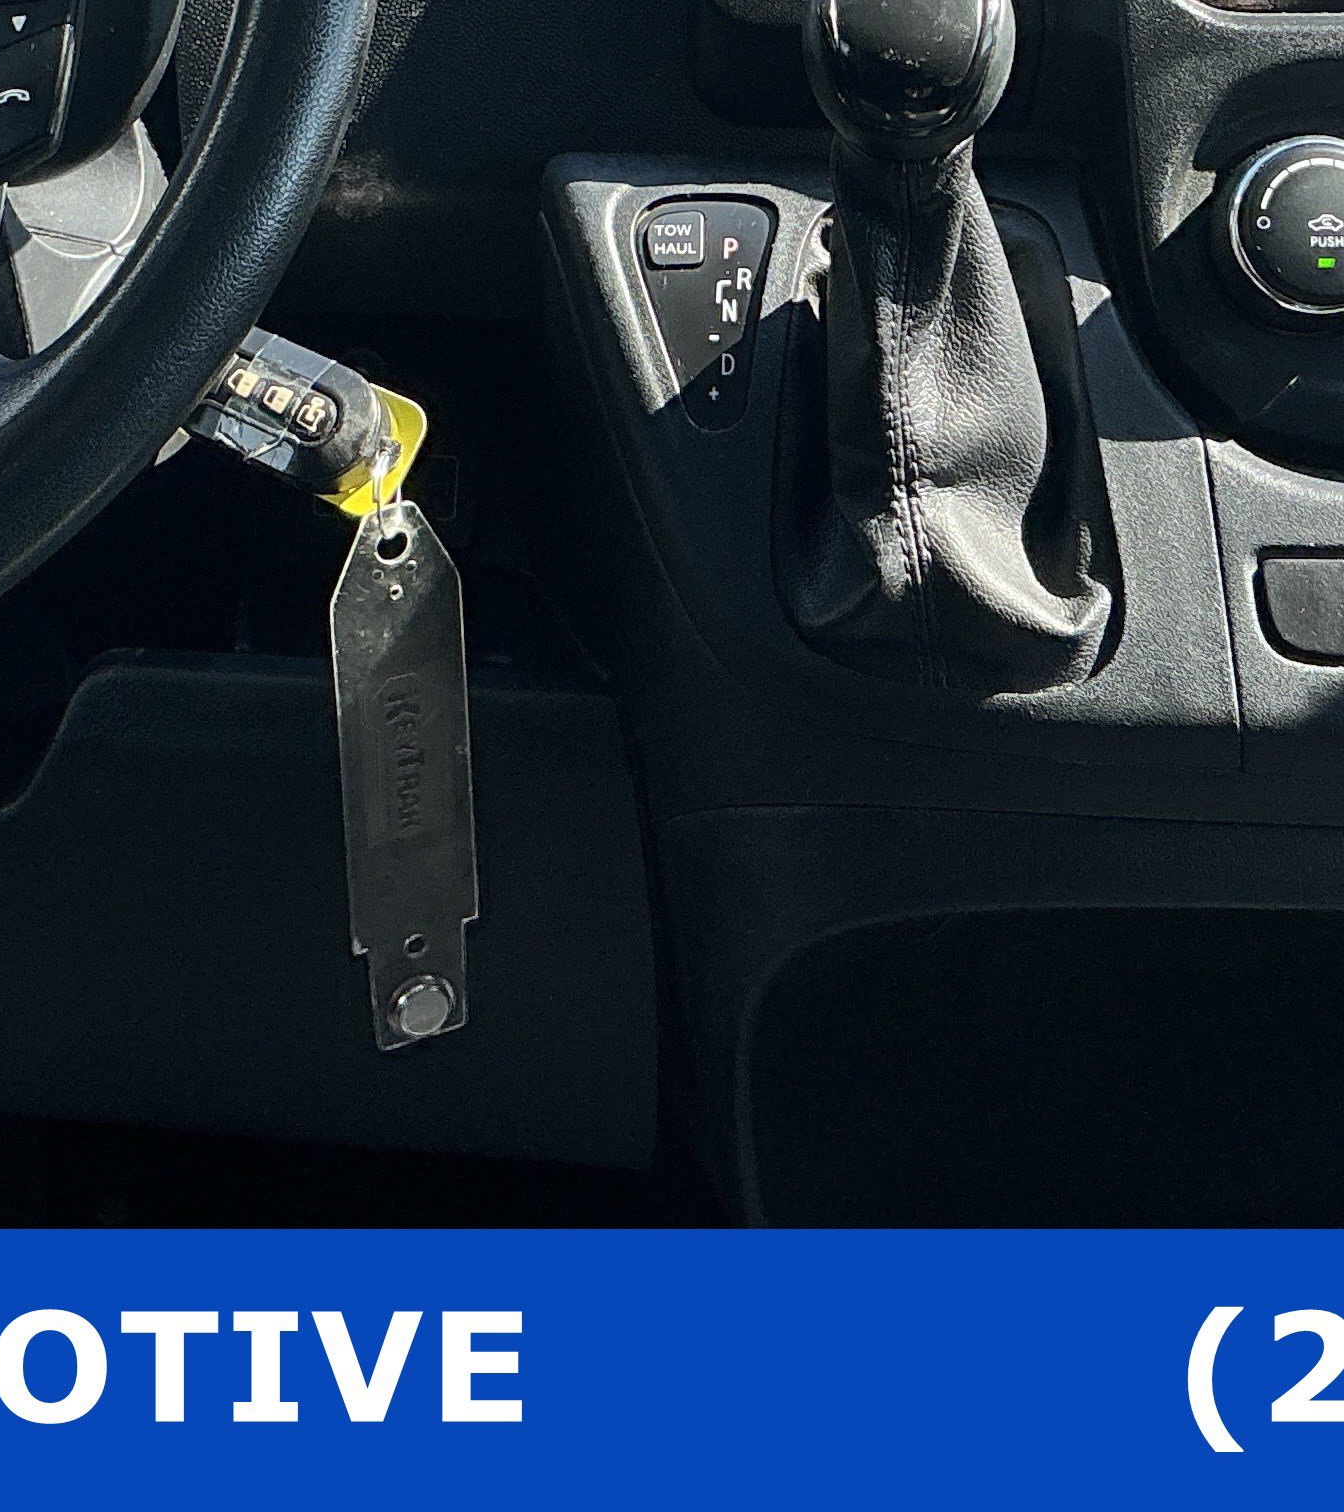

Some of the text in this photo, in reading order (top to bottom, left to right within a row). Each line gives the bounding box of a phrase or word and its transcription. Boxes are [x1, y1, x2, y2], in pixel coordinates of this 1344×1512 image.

[654, 224, 692, 237] TOW
[654, 243, 697, 255] HAUL
[723, 238, 739, 259] P
[1310, 235, 1344, 248] PUSH
[736, 268, 752, 291] R
[722, 298, 738, 322] N
[721, 353, 735, 376] D
